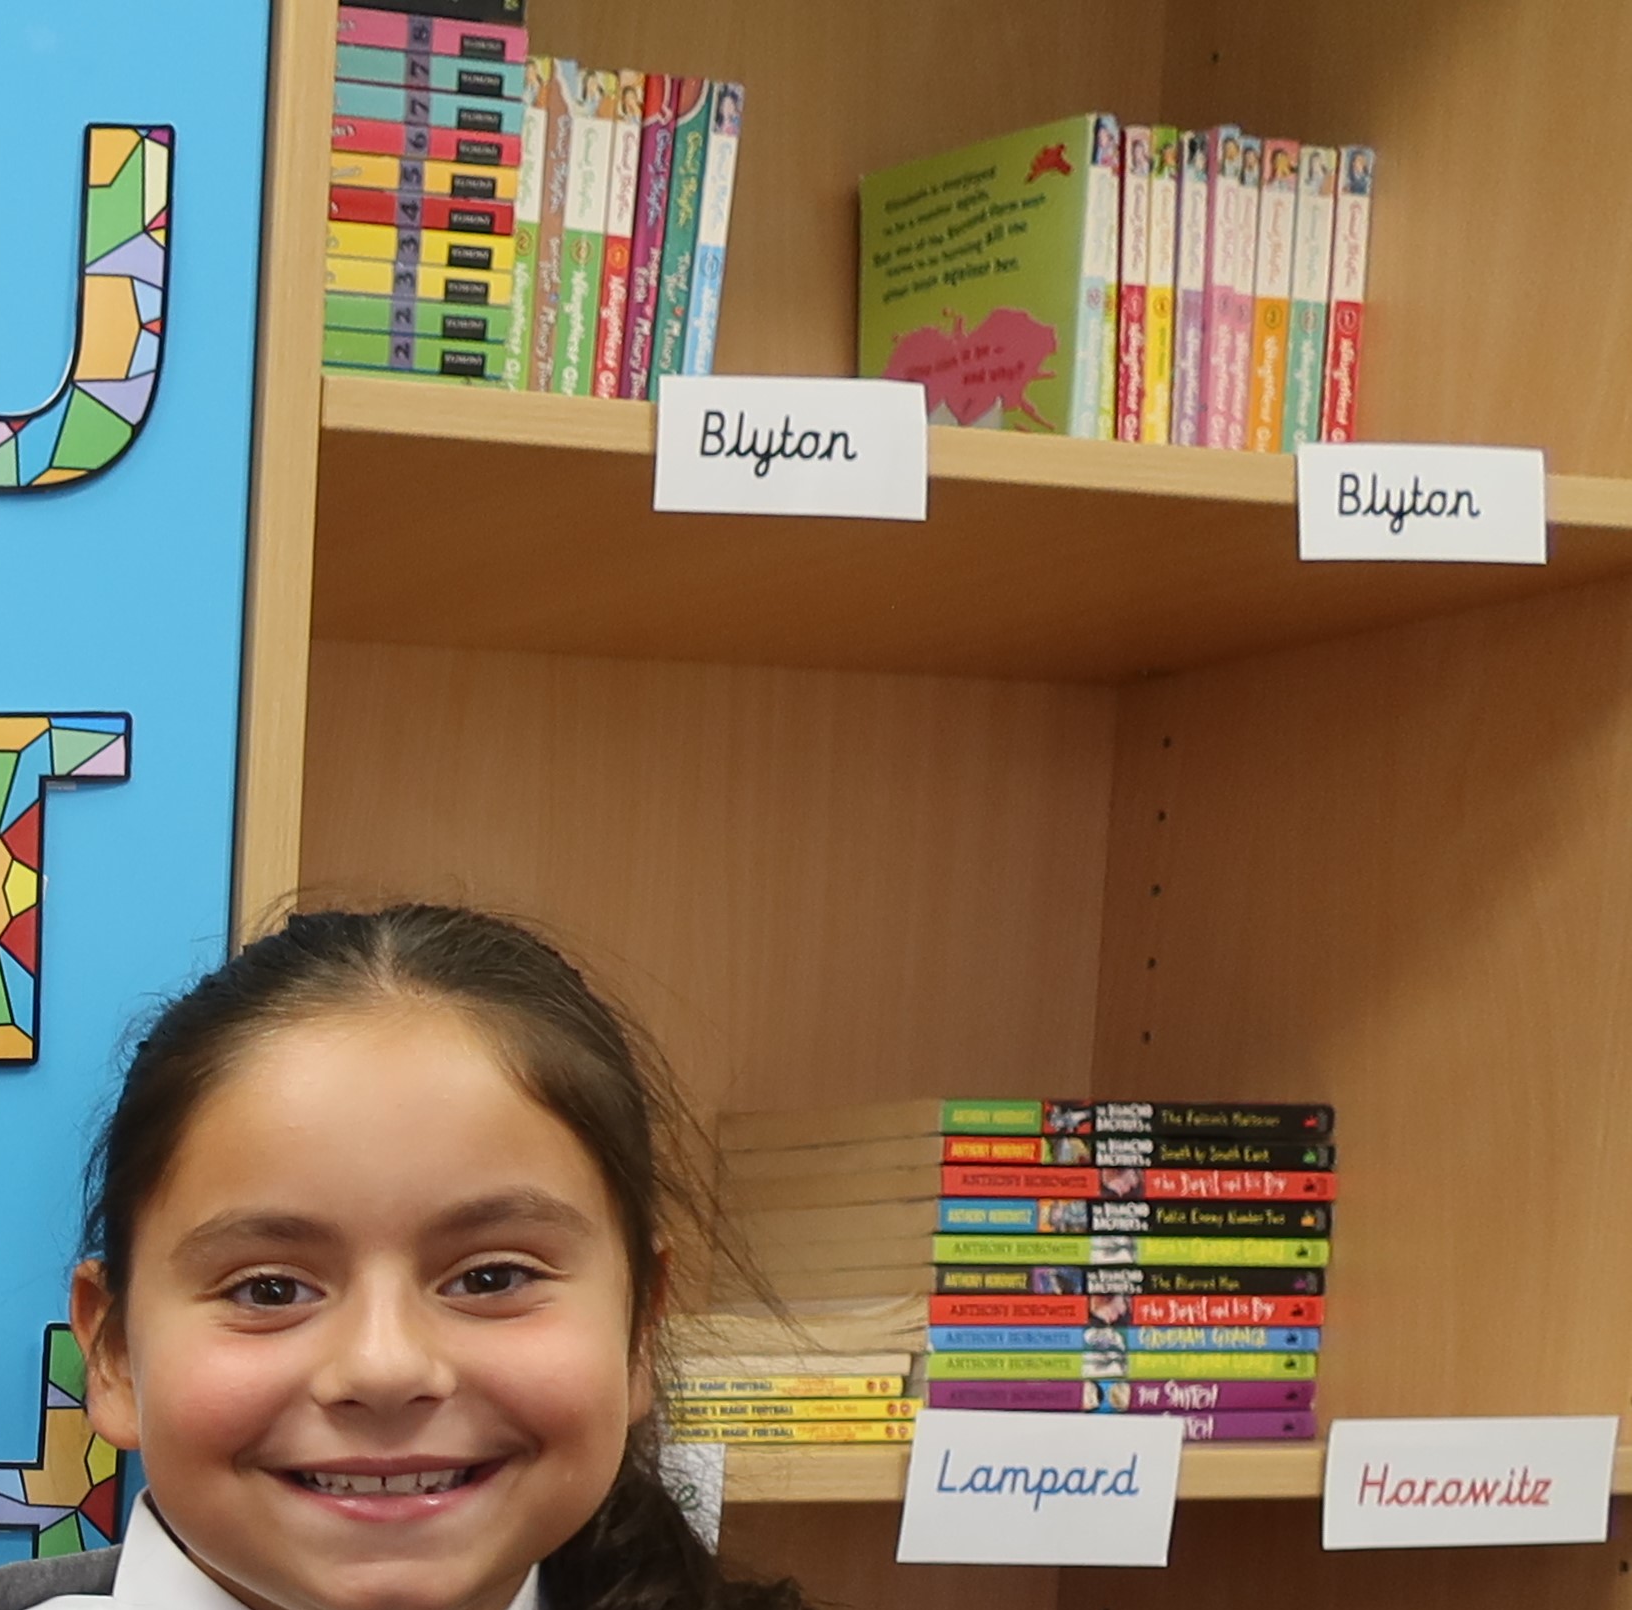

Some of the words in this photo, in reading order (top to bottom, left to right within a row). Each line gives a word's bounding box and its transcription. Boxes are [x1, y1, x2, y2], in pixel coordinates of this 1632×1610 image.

[699, 410, 858, 477] Blyton
[1336, 473, 1482, 533] Blyton
[936, 1451, 1141, 1513] Lampard
[1357, 1465, 1554, 1509] Horowitz
